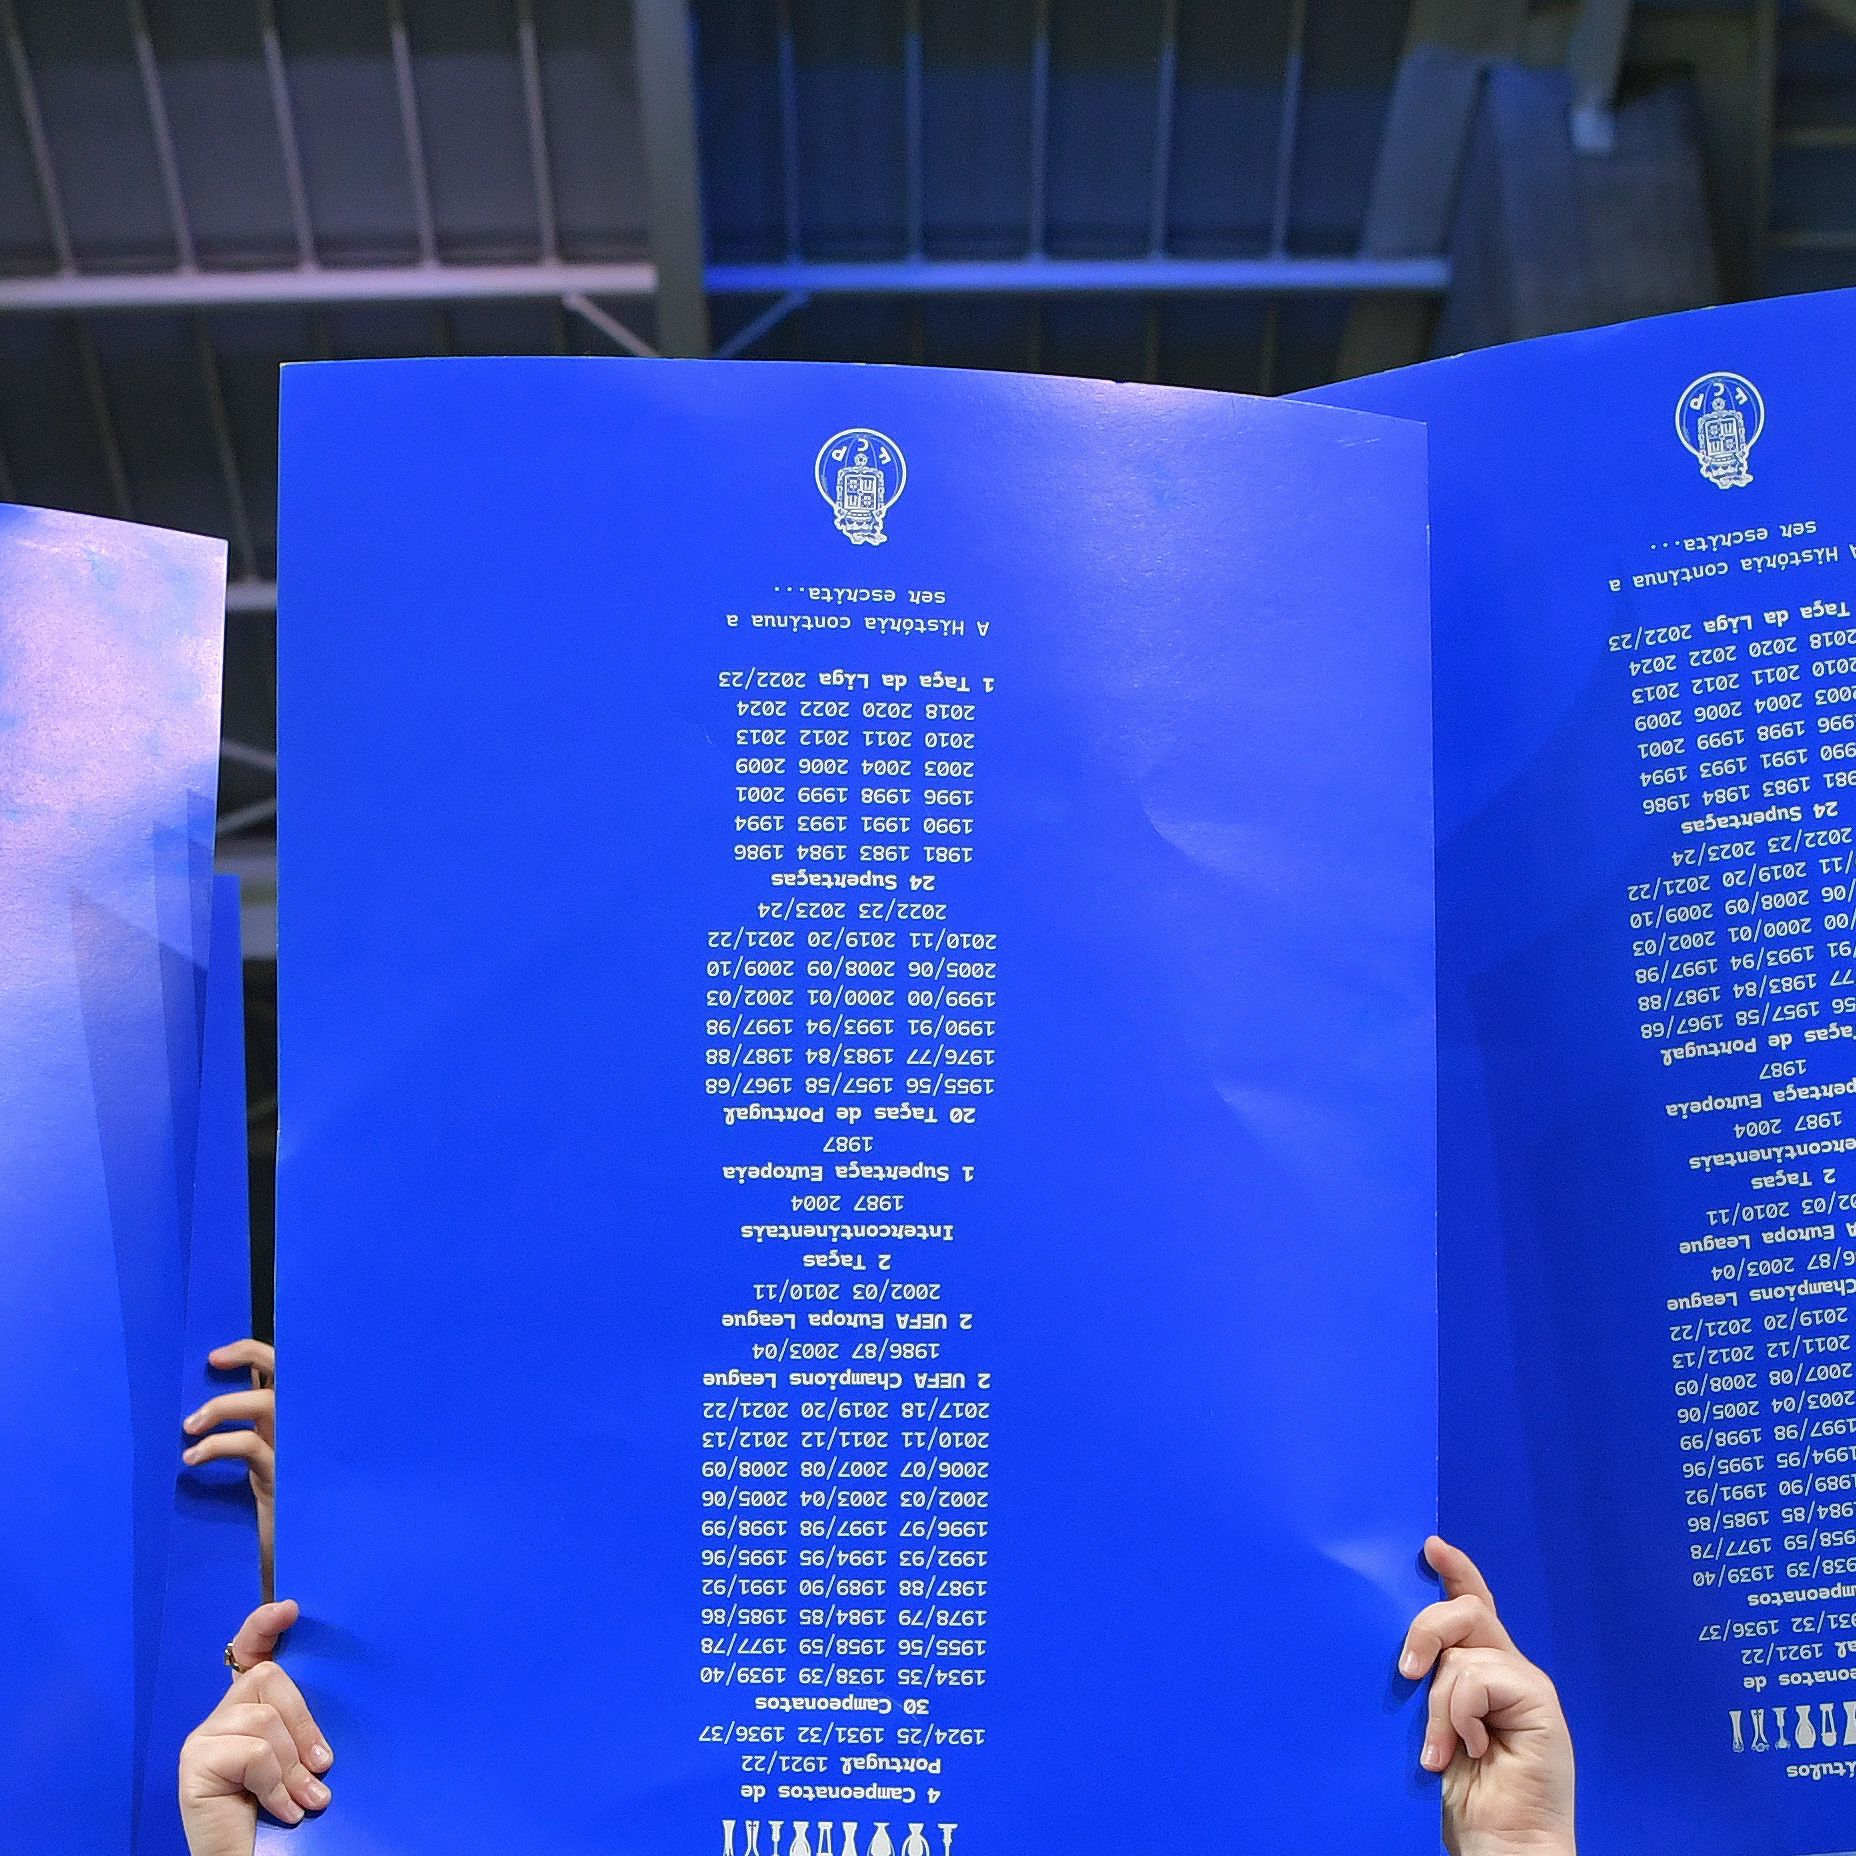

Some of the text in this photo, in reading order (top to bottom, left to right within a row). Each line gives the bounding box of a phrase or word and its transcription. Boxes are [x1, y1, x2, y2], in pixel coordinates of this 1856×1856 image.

[1650, 520, 1818, 553] ser escrita...
[773, 585, 947, 607] ser escrita...
[1762, 609, 1790, 629] da
[1799, 599, 1852, 620] Taça
[725, 613, 991, 638] A História continua a
[1702, 614, 1754, 635] Liga
[1608, 623, 1694, 653] 2022/23
[718, 666, 996, 694] 1 Taça da Liga 2022/23
[1696, 728, 1746, 752] 1999
[1756, 719, 1806, 743] 1998
[1636, 737, 1687, 761] 2001
[733, 844, 975, 864] 1981 1983 1984 1986
[770, 868, 936, 892] 24 Supertaças
[1727, 917, 1813, 944] 2000/01
[1632, 930, 1717, 958] 2002/03
[1659, 1037, 1758, 1068] Portugal
[1767, 1032, 1794, 1052] de
[705, 1071, 996, 1098] 1955/56 1957/58 1967/68
[722, 1101, 977, 1127] 20 Taças de Portugal
[822, 1136, 875, 1154] 1987
[722, 1160, 976, 1186] 1 Supertaça Europeia
[1705, 1201, 1791, 1227] 2010/11
[740, 1224, 955, 1244] Intercontinentais
[1678, 1234, 1752, 1255] League
[1760, 1224, 1836, 1245] Europa
[802, 1249, 892, 1272] 2 Taças
[721, 1308, 974, 1331] 2 UEFA Europa League
[1669, 1317, 1753, 1343] 2021/22
[1763, 1306, 1849, 1332] 2019/20
[751, 1337, 942, 1363] 1986/87 2003/04
[702, 1367, 992, 1392] 2 UEFA Champions League
[1698, 1618, 1780, 1643] 1936/37
[700, 1661, 988, 1689] 1934/35 1938/39 1939/40
[754, 1693, 930, 1716] 30 Campeonatos
[741, 1750, 942, 1776] Portugal 1921/22
[740, 1782, 942, 1805] 4 Campeonatos de
